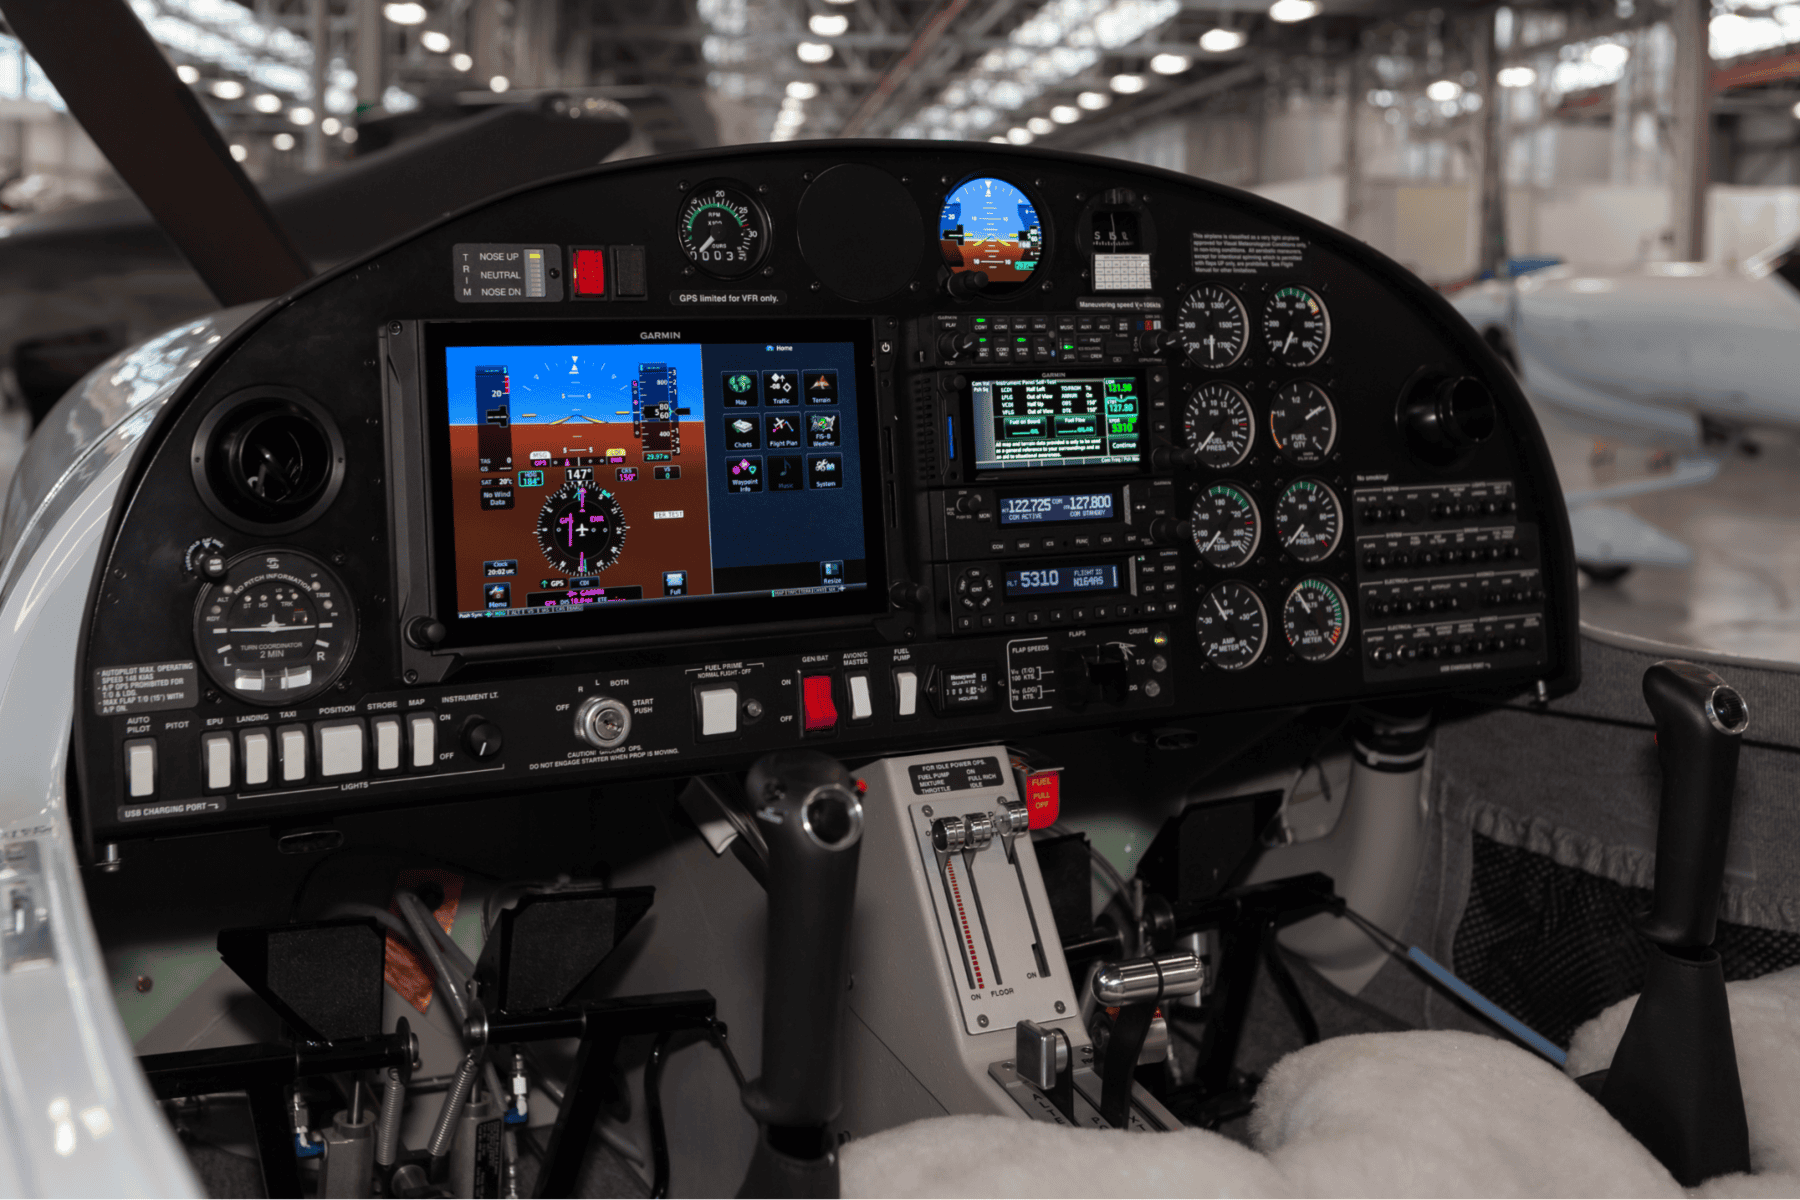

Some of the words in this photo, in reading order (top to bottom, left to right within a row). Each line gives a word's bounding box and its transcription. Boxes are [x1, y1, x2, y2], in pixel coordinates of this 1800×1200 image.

[715, 190, 725, 198] 20
[739, 206, 748, 214] 25
[748, 230, 758, 238] 30
[480, 253, 505, 261] NOSE
[507, 253, 519, 261] UP
[481, 271, 521, 279] NEUTRAL
[482, 288, 506, 296] NOSE
[508, 288, 522, 296] DN
[679, 294, 698, 302] GPS
[700, 294, 726, 302] limited
[728, 294, 740, 302] for
[742, 294, 759, 302] VFR
[760, 294, 779, 304] only.
[1080, 302, 1115, 310] Maneuvering
[1117, 302, 1134, 310] speed
[640, 332, 681, 340] GARMIN
[770, 440, 785, 448] Flight
[816, 481, 836, 489] System
[1008, 498, 1051, 514] 122.725
[1070, 495, 1112, 511] 127.800
[234, 585, 245, 595] NO
[244, 574, 265, 589] PITCH
[266, 573, 312, 592] INFORMATION
[1020, 570, 1059, 589] 5310
[1068, 630, 1087, 638] FLAPS
[1129, 627, 1148, 635] CRUISE
[1302, 636, 1322, 645] METER
[258, 642, 303, 650] COORDINATOR
[1012, 646, 1027, 654] FLAP
[1027, 644, 1050, 653] SPEEDS
[1219, 644, 1240, 652] METER
[260, 651, 266, 659] 2
[268, 650, 284, 658] MIN
[317, 651, 326, 661] R
[843, 651, 869, 660] AVIONIC
[893, 654, 911, 662] PUMP
[224, 656, 232, 667] L
[843, 658, 869, 666] MASTER
[102, 667, 138, 677] AUTOPILOT
[157, 662, 194, 672] OPERATING
[704, 664, 722, 672] FUEL
[722, 662, 743, 670] PRIME
[102, 676, 124, 684] SPEED
[138, 673, 154, 681] KIAS
[720, 670, 738, 678] FLIGHT
[115, 683, 129, 691] OPS
[130, 679, 169, 689] PROHIBITED
[610, 679, 630, 687] BOTH
[102, 698, 118, 706] MAX
[119, 696, 137, 705] FLAP
[167, 692, 185, 700] WITH
[408, 698, 426, 707] MAP
[442, 694, 488, 704] INSTRUMENT
[632, 698, 654, 707] START
[319, 705, 356, 715] POSITION
[367, 701, 398, 711] STROBE
[556, 704, 570, 712] OFF
[279, 711, 297, 719] TAXI
[634, 707, 653, 715] PUSH
[126, 716, 151, 725] AUTO
[206, 718, 224, 726] EPU
[236, 713, 270, 724] LANDING
[440, 714, 451, 722] ON
[780, 715, 793, 723] OFF
[126, 725, 151, 734] PILOT
[165, 720, 190, 730] PITOT
[567, 750, 597, 759] CAUTION!
[628, 744, 644, 752] OPS.
[439, 752, 455, 761] OFF
[554, 759, 581, 768] ENGAGE
[581, 756, 609, 765] STARTER
[610, 754, 628, 762] WHEN
[629, 752, 646, 760] PROP
[654, 748, 680, 757] MOVING.
[950, 761, 972, 769] POWER
[341, 782, 369, 791] LIGHTS
[920, 780, 945, 788] MIXTURE
[1031, 777, 1052, 787] FUEL
[921, 786, 951, 794] THROTTLE
[1033, 792, 1051, 800] PULL
[1035, 801, 1049, 809] OFF
[125, 810, 142, 818] USB
[143, 805, 184, 816] CHARGING
[186, 802, 207, 812] PORT
[971, 993, 982, 1001] ON
[990, 988, 1014, 998] FLOOR
